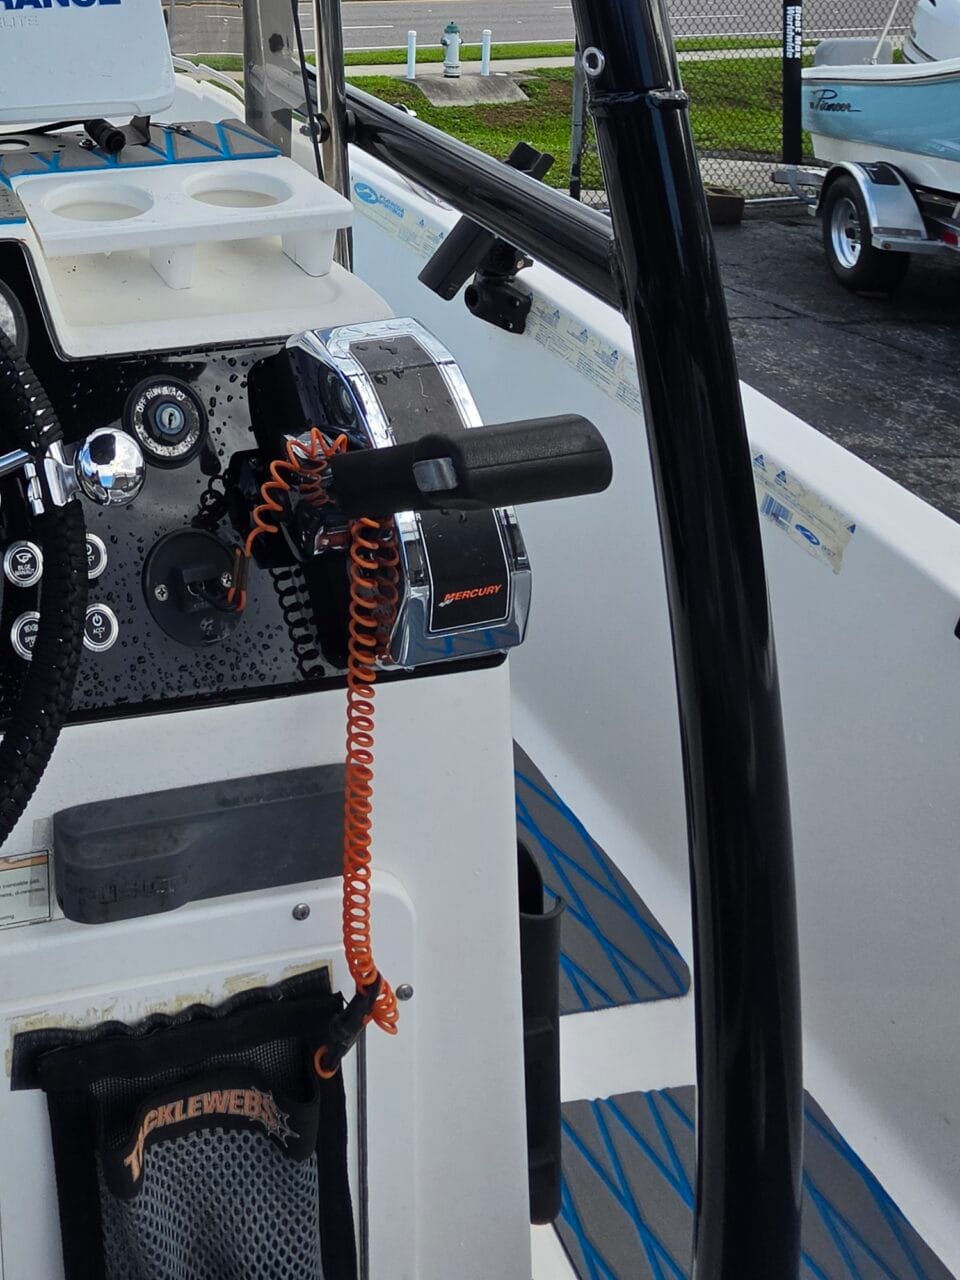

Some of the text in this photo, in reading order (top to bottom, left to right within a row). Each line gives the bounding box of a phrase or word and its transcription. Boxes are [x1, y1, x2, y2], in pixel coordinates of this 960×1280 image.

[786, 6, 795, 59] Worldwide
[811, 88, 863, 113] Pioneer
[444, 584, 502, 602] MERCURY
